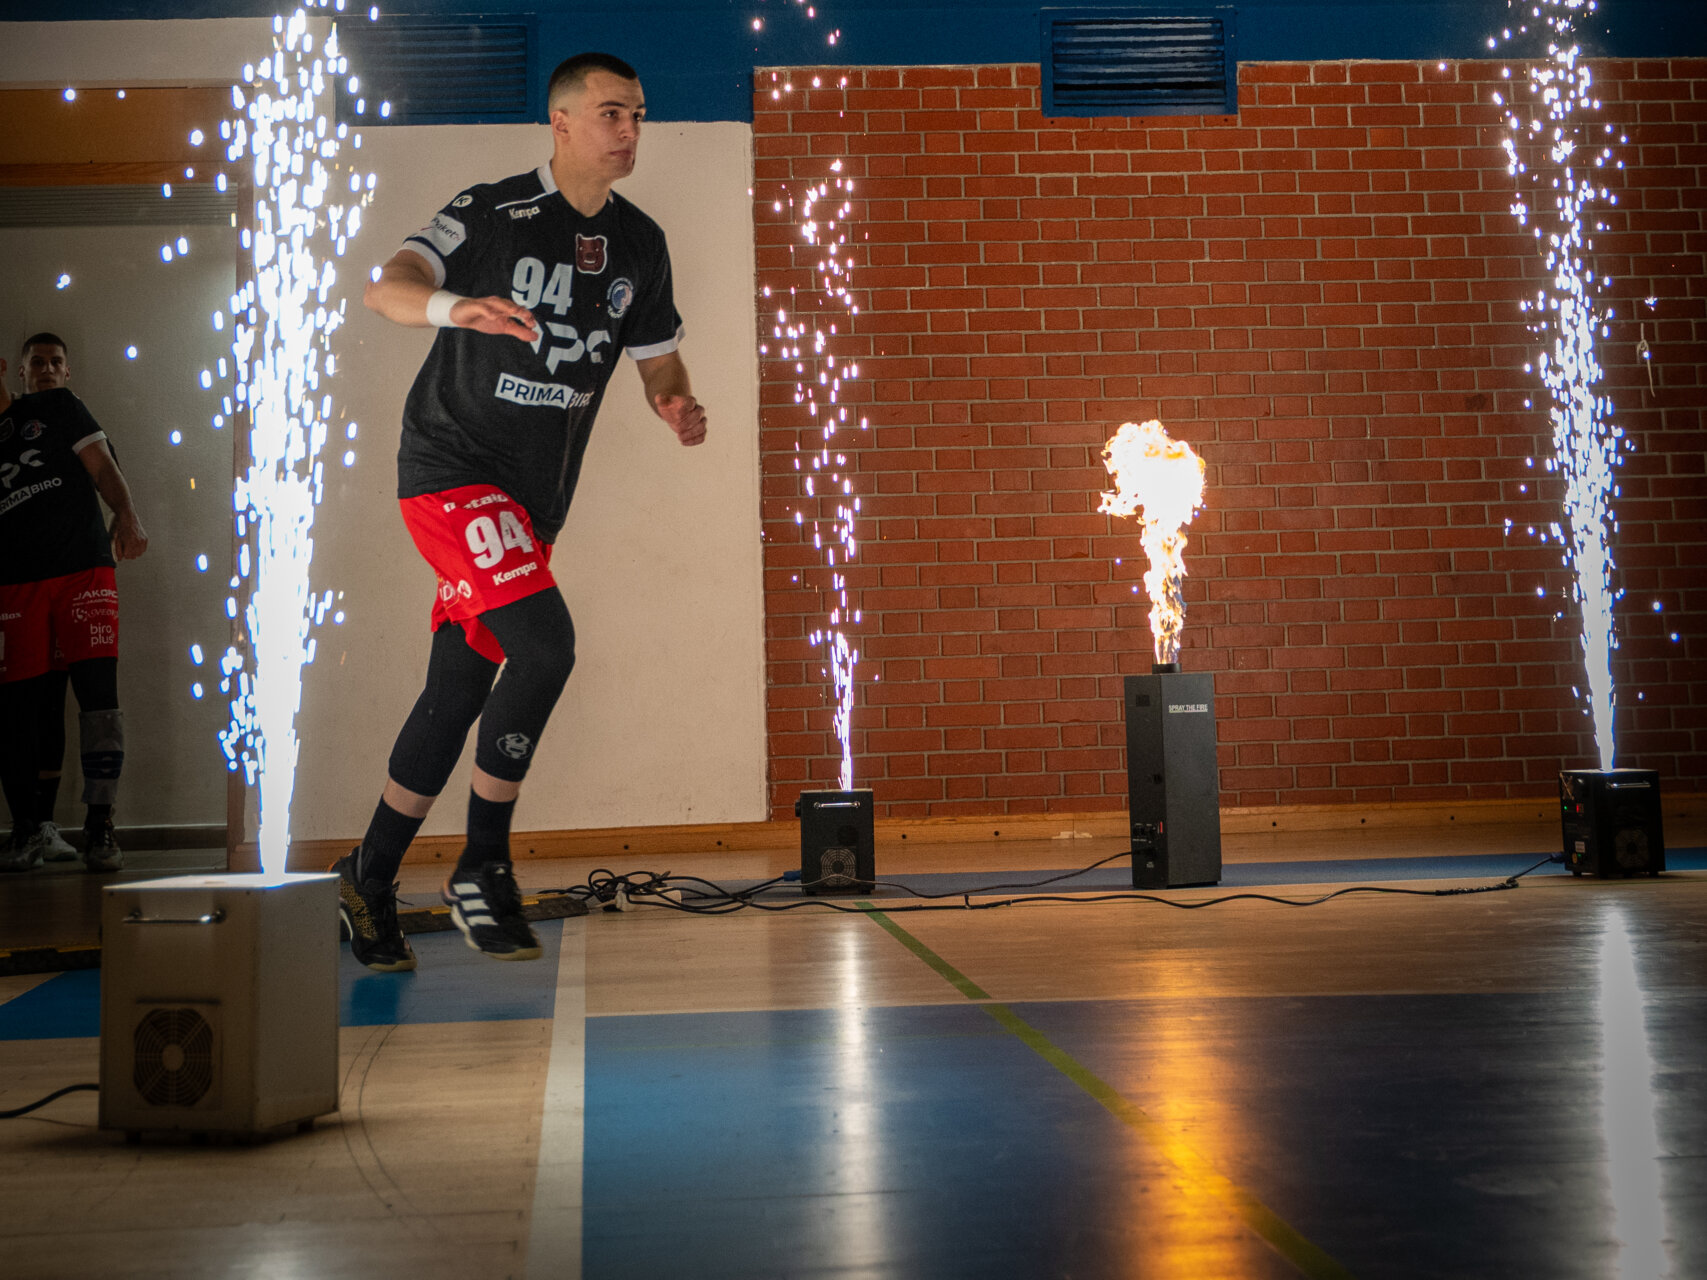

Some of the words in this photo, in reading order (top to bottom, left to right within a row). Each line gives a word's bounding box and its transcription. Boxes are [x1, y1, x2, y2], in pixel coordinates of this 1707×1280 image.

[511, 256, 574, 316] 94
[500, 379, 565, 403] PRIMA
[465, 510, 535, 570] 94
[492, 562, 538, 586] Kempa
[89, 622, 112, 635] biro
[90, 635, 115, 648] plus
[1186, 704, 1196, 712] THE
[1196, 703, 1209, 712] FIRE
